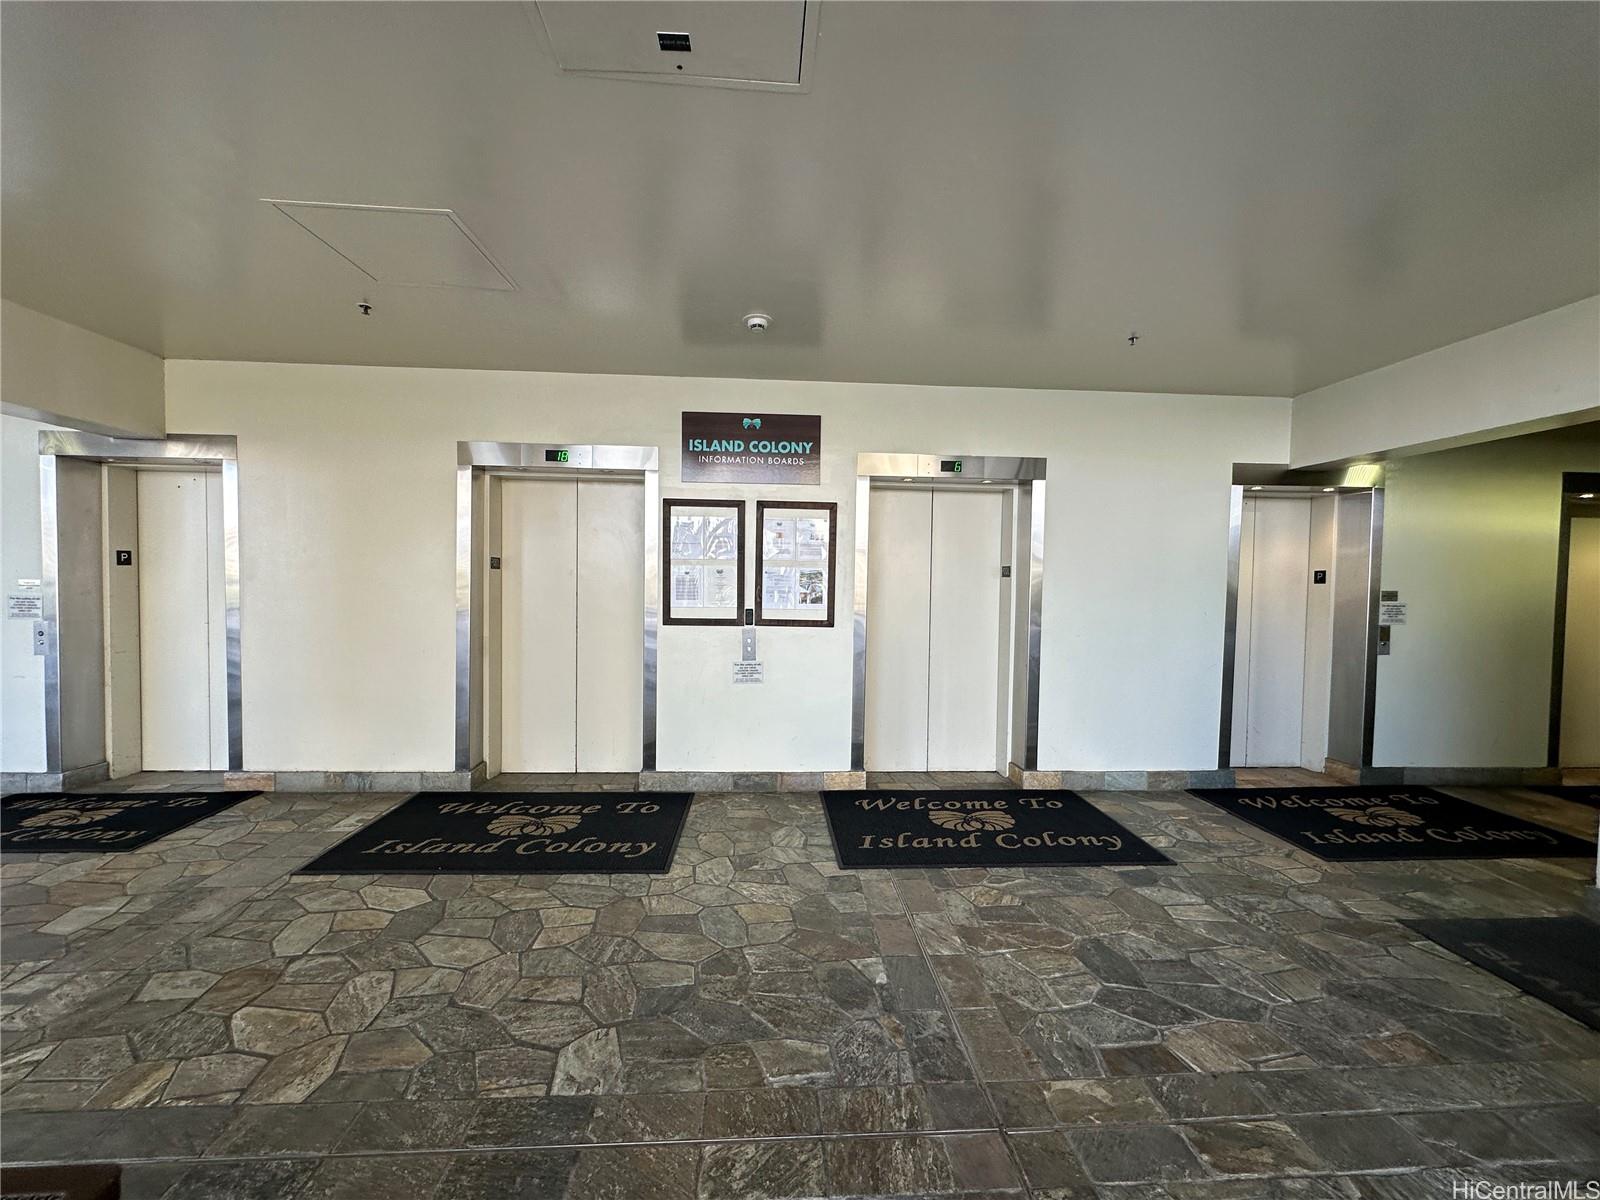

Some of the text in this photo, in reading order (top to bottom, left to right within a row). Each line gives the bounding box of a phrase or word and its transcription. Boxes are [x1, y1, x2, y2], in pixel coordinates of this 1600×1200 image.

[689, 439, 813, 454] ISLAND COLONY
[557, 451, 568, 461] 18
[698, 455, 805, 465] INFORMATION BOARDS
[954, 461, 961, 472] 6
[121, 553, 128, 561] P
[1317, 572, 1323, 580] P
[437, 801, 660, 815] Welcome To
[854, 797, 1064, 811] Welcome To
[1237, 795, 1440, 810] Welcome To
[858, 832, 1122, 851] Island Colony
[1304, 827, 1560, 846] Island Colony
[362, 837, 657, 859] Island Colony
